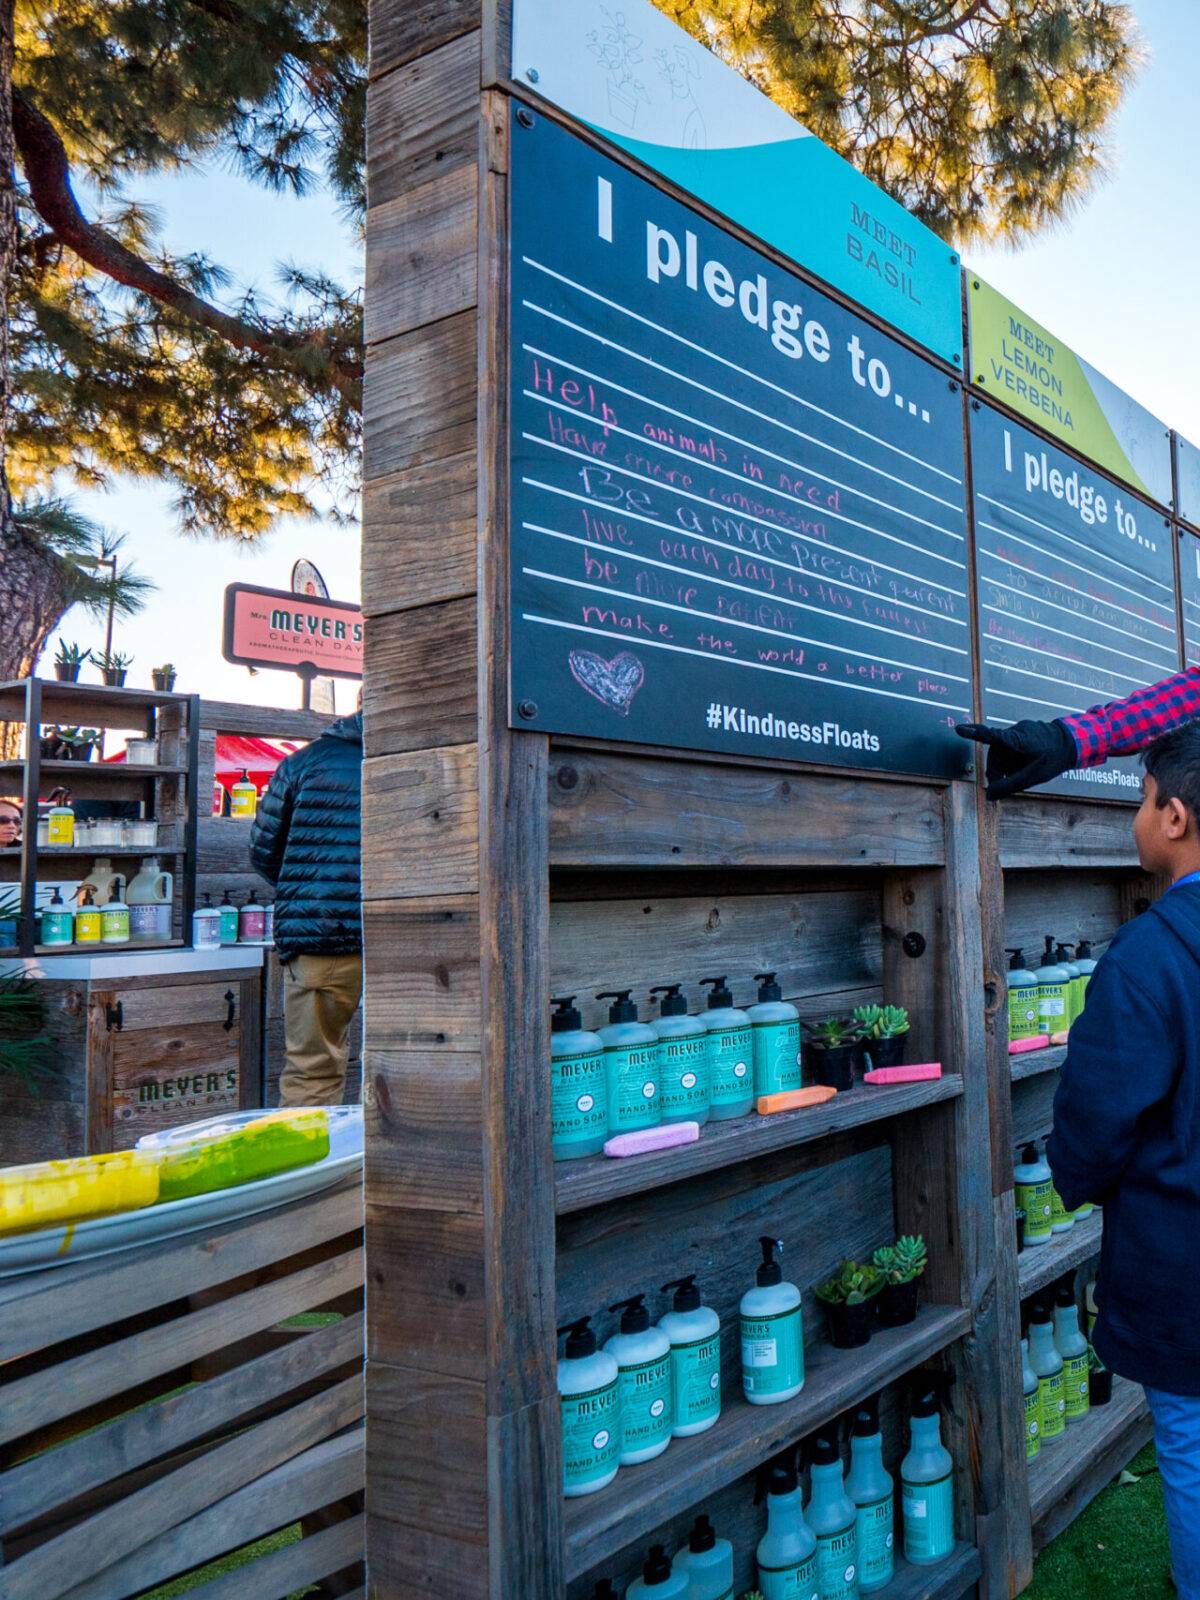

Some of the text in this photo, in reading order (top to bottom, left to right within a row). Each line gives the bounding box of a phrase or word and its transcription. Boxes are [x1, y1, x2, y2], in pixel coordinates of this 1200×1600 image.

[850, 201, 917, 268] MEET
[846, 232, 921, 305] BASIL
[598, 176, 930, 423] I pledge to...
[1008, 316, 1055, 364] MEET
[1002, 339, 1062, 397] LEMON
[990, 358, 1074, 431] VERBENA
[534, 360, 841, 512] Help animals in need
[579, 466, 658, 516] Be
[1003, 429, 1156, 552] I pledge to...
[728, 556, 775, 589] day
[1196, 549, 1200, 580] I
[269, 633, 362, 653] CLEAN DAY
[270, 609, 362, 642] MEYER'S
[697, 632, 738, 654] the
[758, 649, 804, 665] world
[845, 663, 902, 682] better
[706, 703, 880, 751] #KindnessFloats
